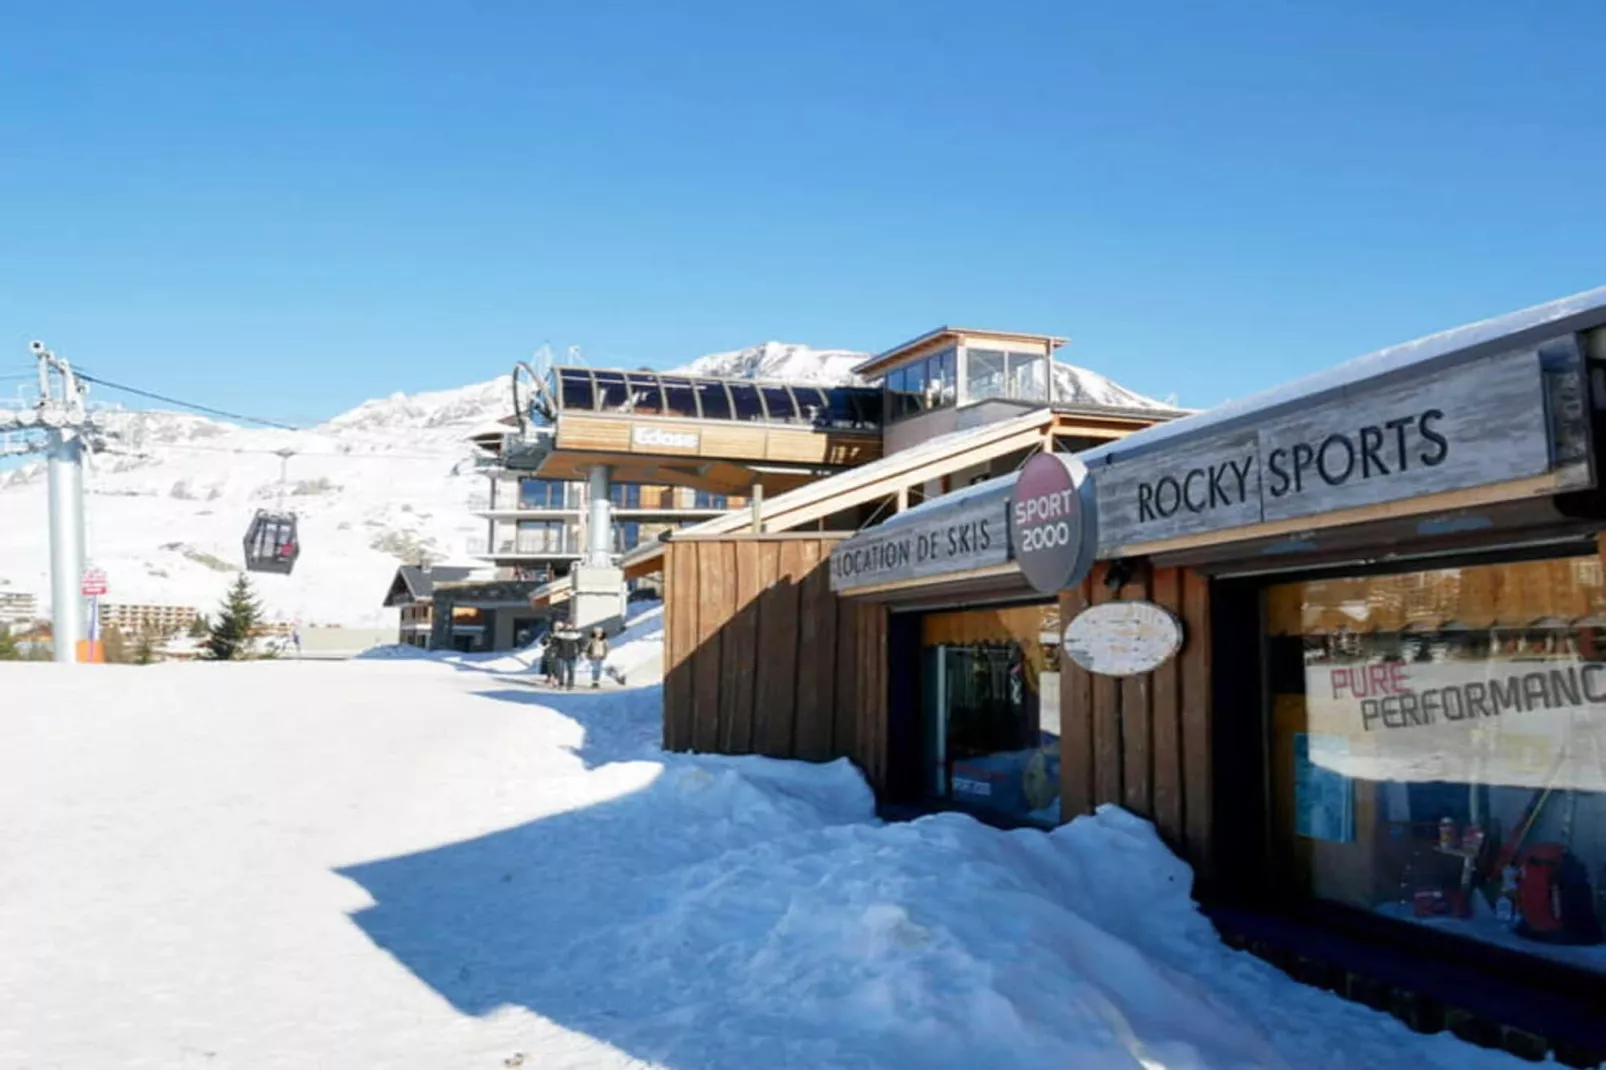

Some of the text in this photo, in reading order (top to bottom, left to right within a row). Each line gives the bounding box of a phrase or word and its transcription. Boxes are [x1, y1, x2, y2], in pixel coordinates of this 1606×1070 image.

[1138, 409, 1448, 523] ROCKY SPORTS
[1015, 490, 1071, 524] SPORT
[837, 520, 991, 578] LOCATION DE SKIS
[1022, 522, 1069, 552] 2000
[1330, 662, 1412, 699] PURE
